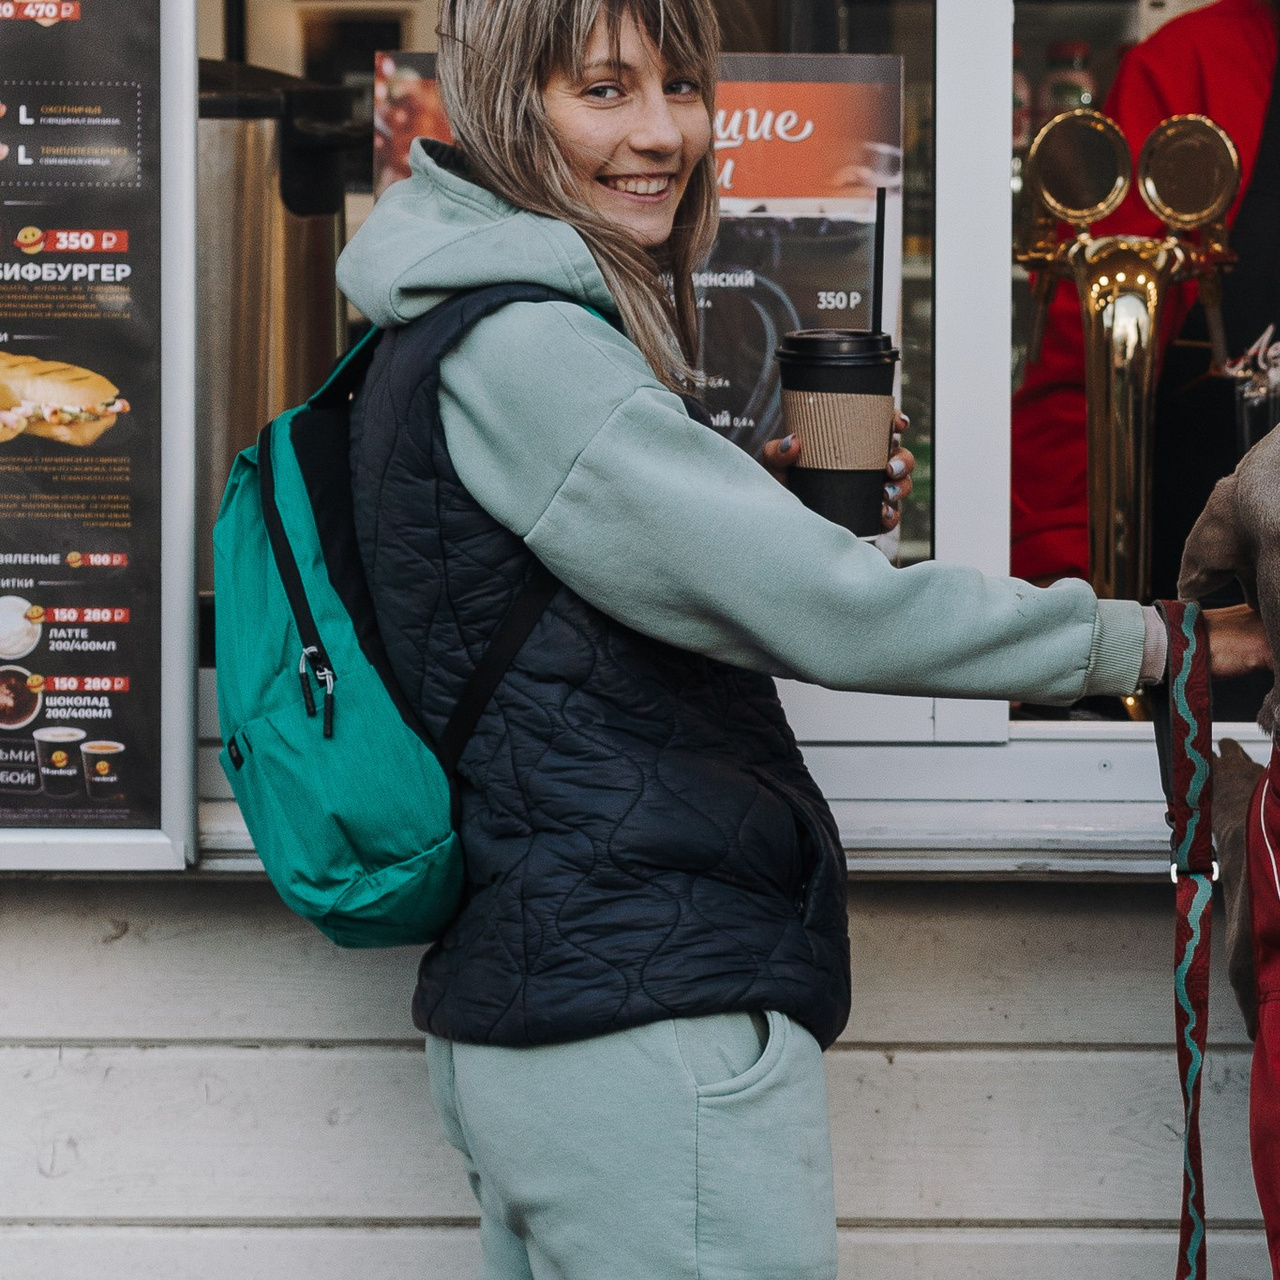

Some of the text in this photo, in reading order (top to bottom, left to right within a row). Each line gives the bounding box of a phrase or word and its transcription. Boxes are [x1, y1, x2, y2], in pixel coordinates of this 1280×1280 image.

[23, 4, 58, 18] 470
[19, 105, 35, 125] L
[18, 144, 34, 165] L
[55, 231, 95, 250] 350
[0, 262, 132, 282] ИФБУРГЕР
[816, 291, 848, 310] 350
[89, 554, 111, 566] 100
[53, 608, 78, 622] 150
[83, 608, 111, 622] 280
[49, 628, 88, 639] ЛАТТЕ
[49, 640, 117, 651] 200/400МЛ
[53, 677, 78, 691] 150
[83, 677, 111, 691] 280
[45, 696, 110, 707] ШОКОЛАД
[45, 708, 113, 719] 200/400МЛ
